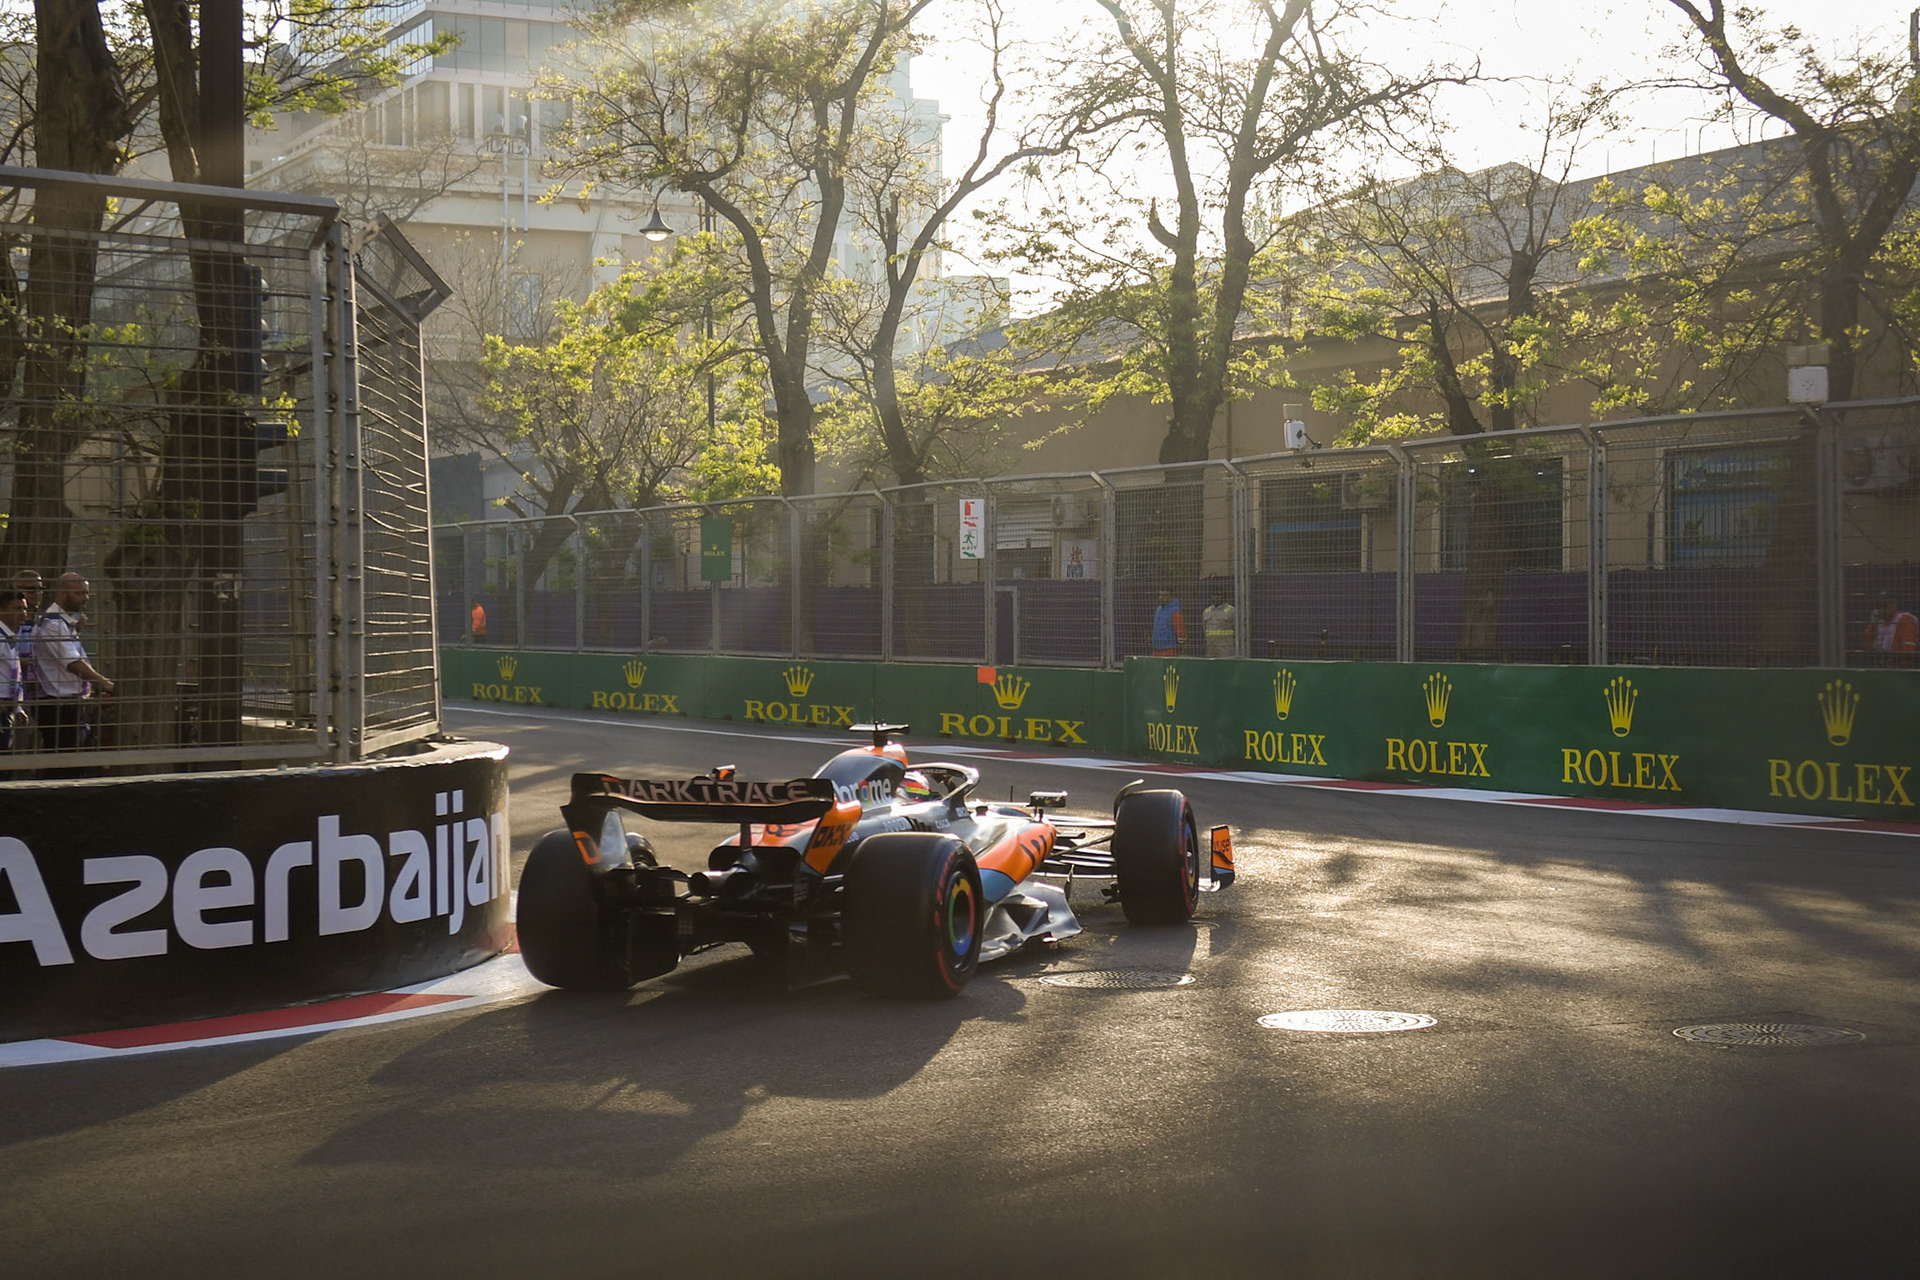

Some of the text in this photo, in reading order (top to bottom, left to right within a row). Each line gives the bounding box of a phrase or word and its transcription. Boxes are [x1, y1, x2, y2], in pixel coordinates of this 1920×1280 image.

[472, 683, 543, 704] ROLEX
[592, 691, 680, 713] ROLEX
[744, 700, 854, 728] ROLEX
[939, 712, 1089, 744] ROLEX
[1147, 722, 1201, 756] ROLEX
[1244, 730, 1328, 767] ROLEX
[1386, 738, 1492, 778] ROLEX
[1562, 748, 1682, 792] ROLEX
[603, 779, 811, 804] DARKTRACE
[1769, 759, 1915, 807] ROLEX
[0, 789, 508, 967] Azerbaijan
